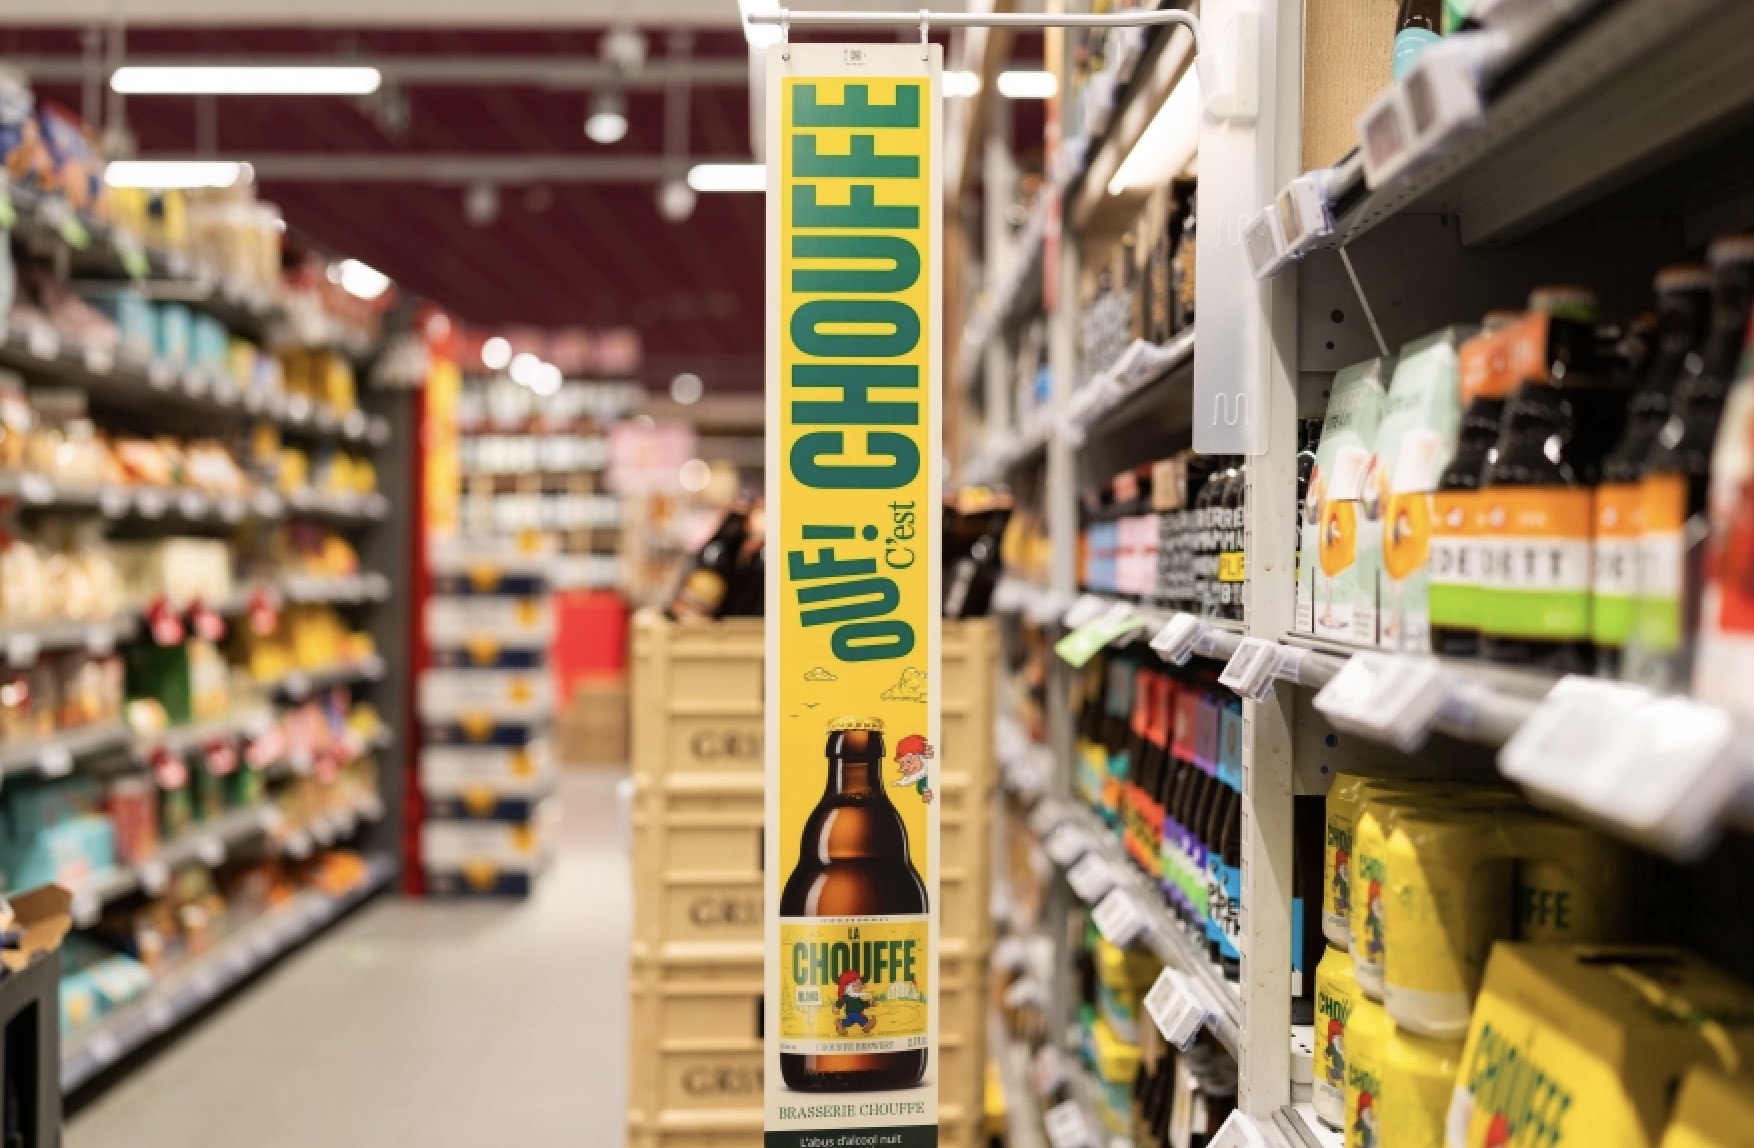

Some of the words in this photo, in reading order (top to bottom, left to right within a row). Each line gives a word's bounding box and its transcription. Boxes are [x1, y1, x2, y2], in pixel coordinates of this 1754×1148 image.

[790, 84, 921, 489] CHOUFFE
[885, 500, 915, 569] C'est
[788, 524, 915, 663] OUF!
[848, 927, 860, 940] LA
[793, 940, 916, 986] CHOUFFE
[779, 1104, 855, 1120] BRASSERIE
[860, 1101, 924, 1117] CHOUFFE
[800, 1137, 834, 1148] L'abus
[838, 1134, 878, 1146] d'alcool
[880, 1134, 902, 1144] nuit
